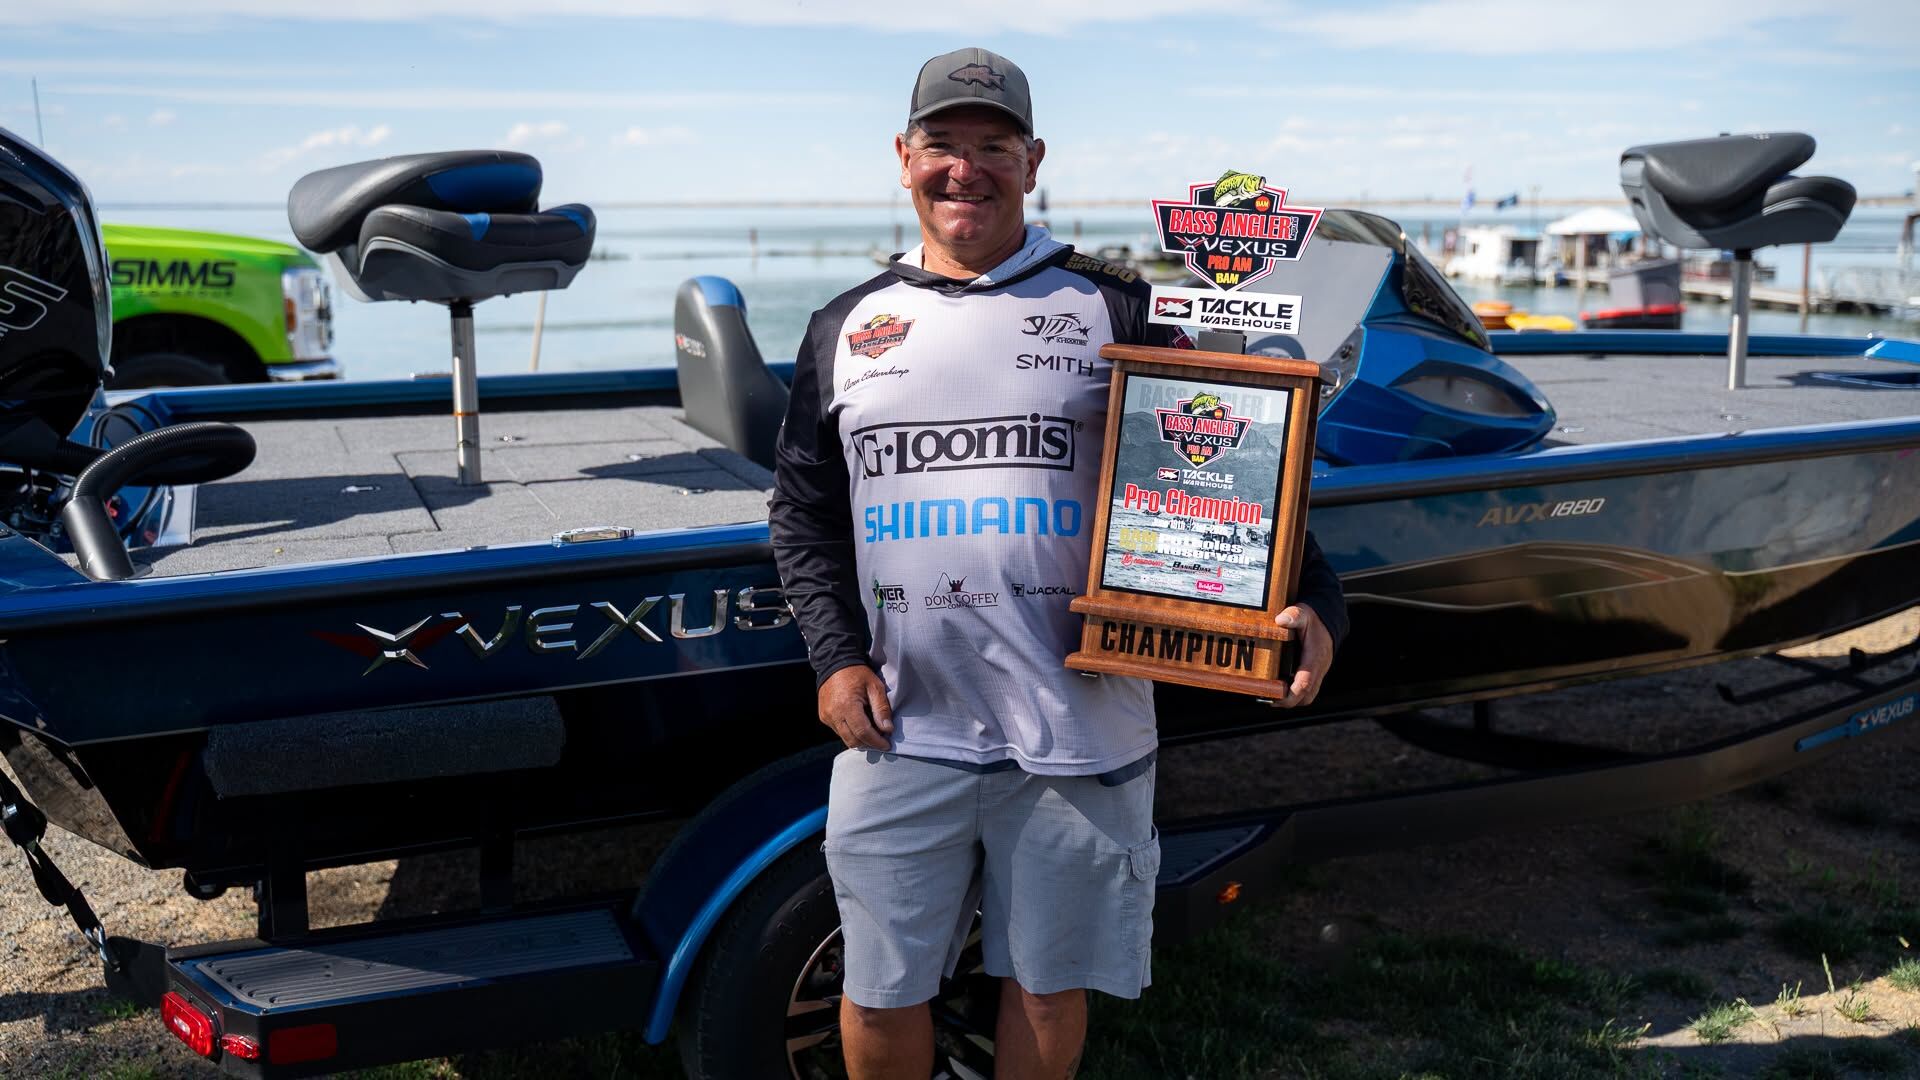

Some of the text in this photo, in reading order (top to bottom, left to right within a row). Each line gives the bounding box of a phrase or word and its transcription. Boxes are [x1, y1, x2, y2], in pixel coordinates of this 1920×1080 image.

[1169, 209, 1217, 233] BASS
[1221, 213, 1291, 240] ANGLER
[1201, 237, 1287, 256] VEXUS
[111, 259, 236, 288] SIMMS
[1207, 255, 1253, 272] PRO AM
[1215, 272, 1240, 285] BAM
[1198, 297, 1294, 319] TACKLE
[1200, 315, 1292, 330] WAREHOUSE
[1016, 353, 1093, 377] SMITH
[1165, 415, 1236, 437] BASS ANGLER
[1184, 432, 1233, 447] VEXUS
[1182, 469, 1234, 484] TACKLE
[1182, 479, 1234, 490] WAREHOUSE
[1124, 483, 1263, 526] Pro Champion
[1475, 498, 1605, 528] AVX 1880
[865, 496, 1082, 543] SHIMANO
[925, 592, 998, 606] DON COFFEY
[1026, 586, 1076, 595] JACKAL
[886, 601, 909, 613] PRO
[440, 588, 796, 660] VEXUS
[1101, 621, 1255, 671] CHAMPION
[1870, 696, 1914, 725] VEXUS
